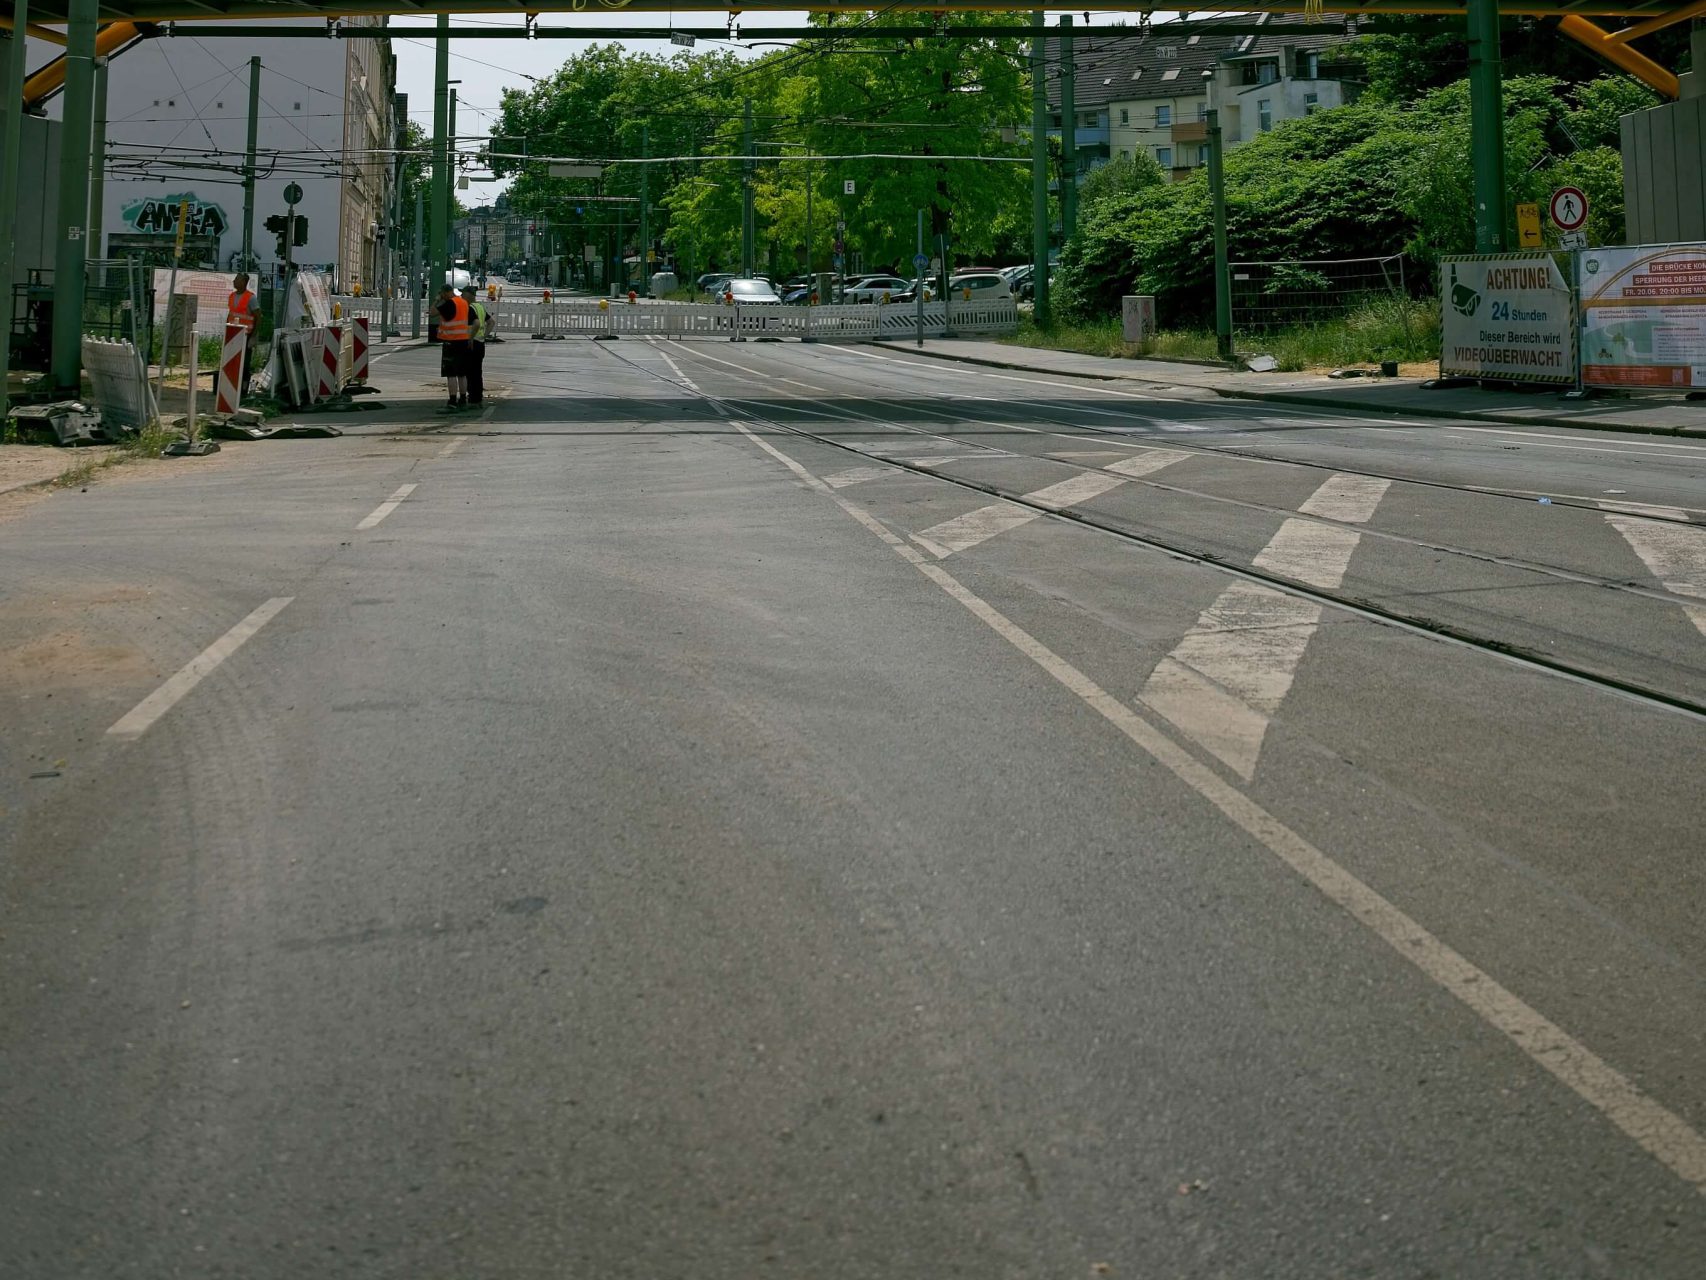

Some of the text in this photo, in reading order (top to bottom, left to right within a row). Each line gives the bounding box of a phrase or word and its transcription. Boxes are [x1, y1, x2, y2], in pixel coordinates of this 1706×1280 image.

[1664, 262, 1692, 271] BRÜCKE
[1486, 267, 1551, 290] ACHTUNG!
[1635, 276, 1672, 284] SPERRUNG
[1673, 275, 1687, 283] DER
[1491, 301, 1547, 321] 24 Stunden
[1480, 330, 1561, 345] Dieser Bereich wird
